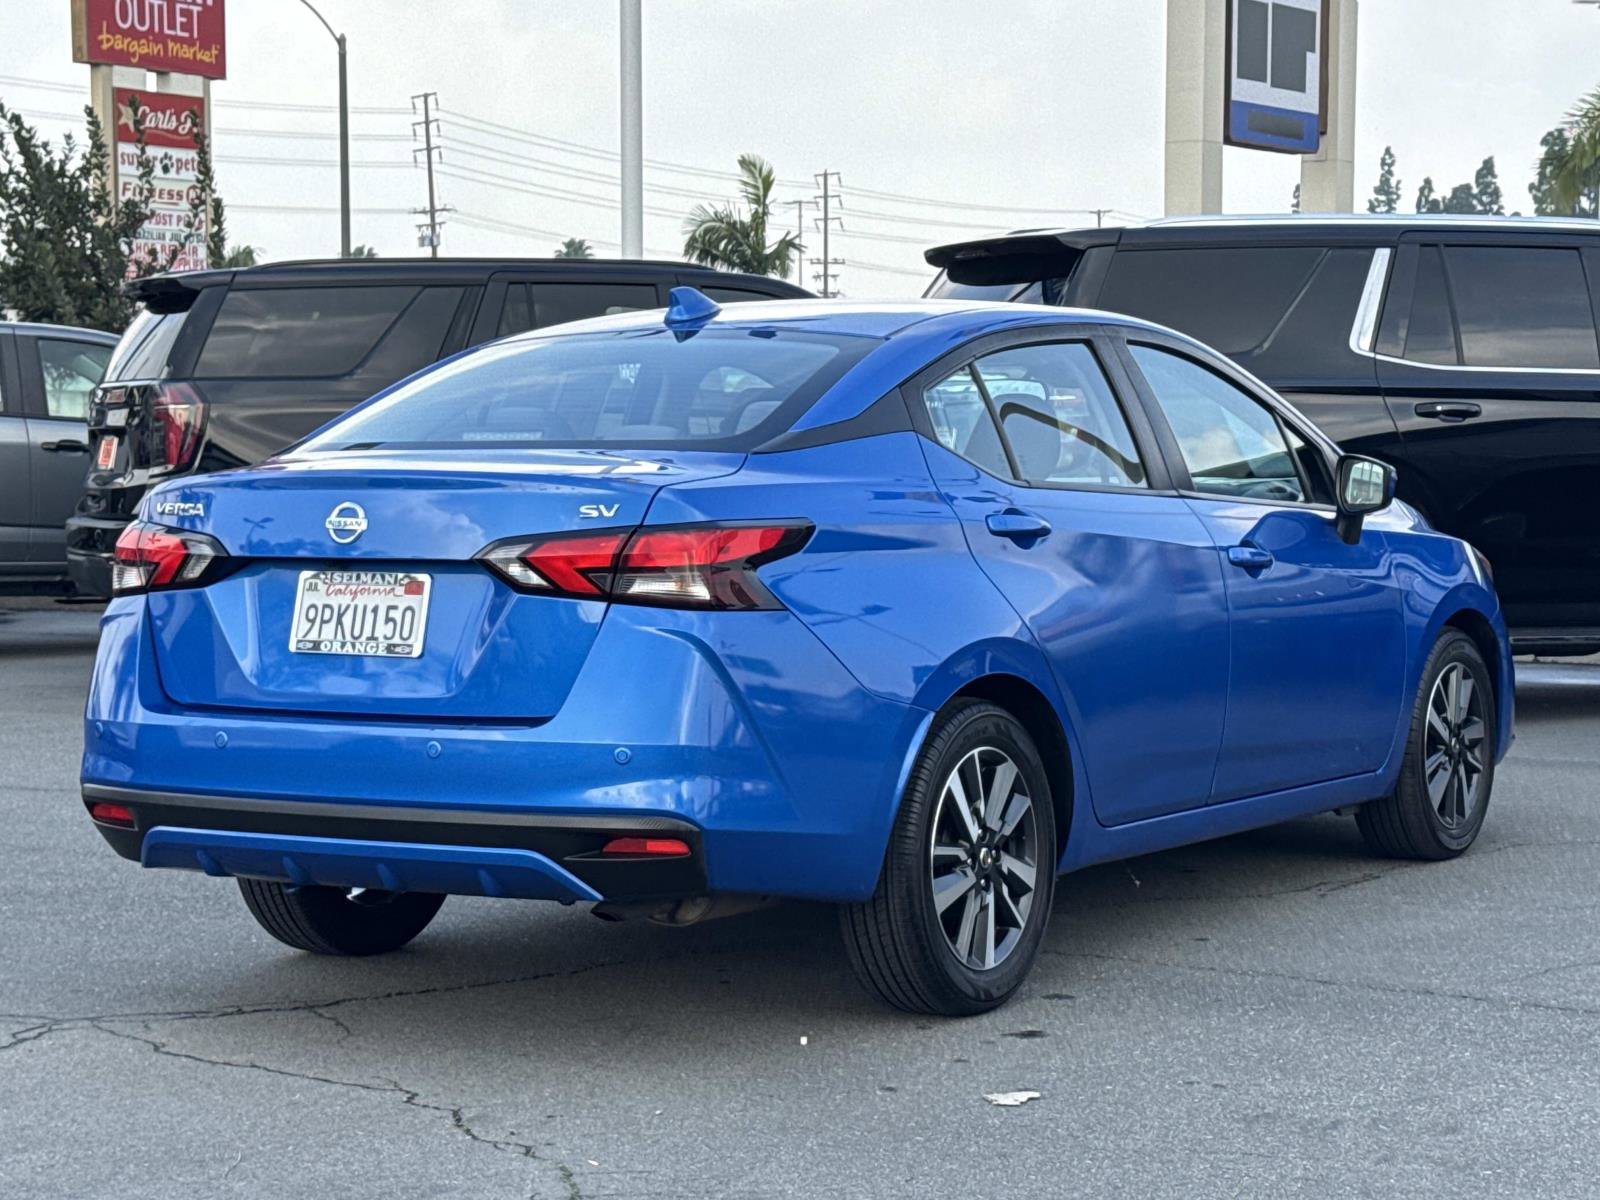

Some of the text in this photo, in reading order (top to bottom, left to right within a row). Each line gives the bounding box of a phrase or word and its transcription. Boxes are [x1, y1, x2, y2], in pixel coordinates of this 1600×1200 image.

[115, 0, 203, 39] OUTLET
[97, 20, 220, 64] bargain market
[137, 105, 178, 131] Carl's
[156, 502, 205, 517] VERSA
[579, 503, 620, 518] SV
[327, 519, 363, 528] NISSAN
[331, 572, 396, 585] SELMAN
[305, 581, 320, 592] JUL
[325, 583, 404, 601] California
[301, 603, 417, 641] 9PKU150
[320, 641, 387, 653] ORANGE
